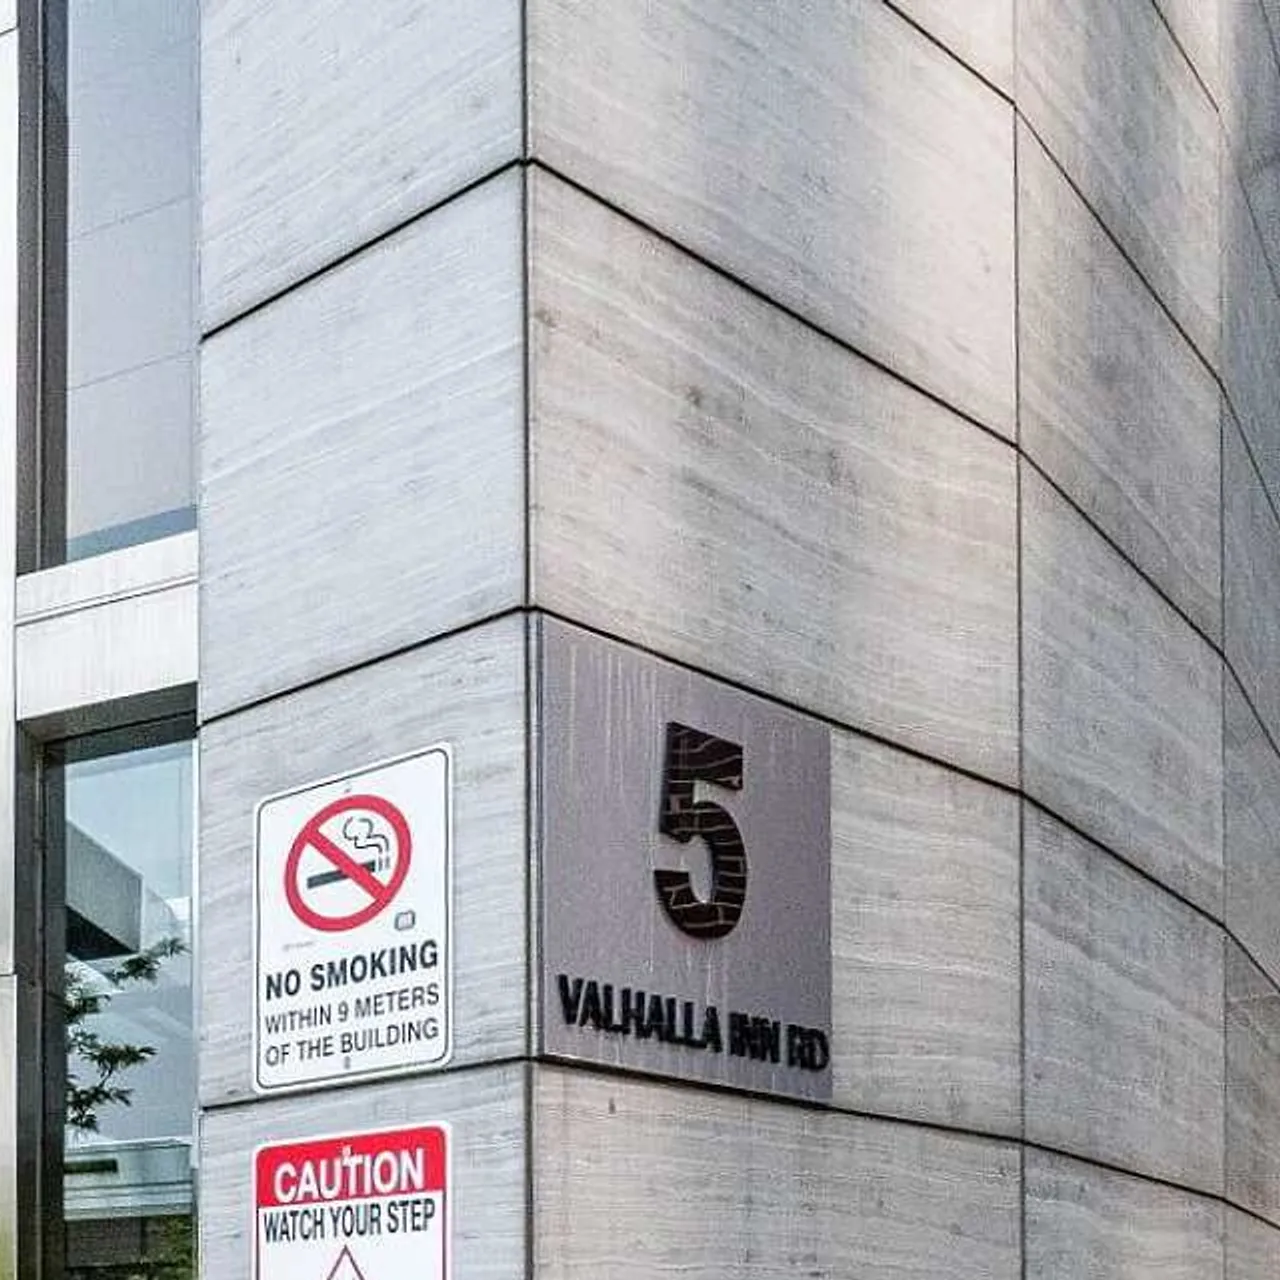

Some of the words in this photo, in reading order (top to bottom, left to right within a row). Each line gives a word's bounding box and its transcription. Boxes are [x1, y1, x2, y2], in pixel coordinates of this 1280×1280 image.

[654, 720, 748, 940] 5
[265, 969, 301, 1001] NO
[310, 939, 438, 992] SMOKING
[265, 1003, 332, 1035] WITHIN
[339, 1001, 350, 1022] 9
[355, 982, 440, 1019] METERS
[558, 974, 723, 1054] VALHALLA
[728, 1011, 781, 1065] INN
[786, 1023, 831, 1072] RD
[265, 1043, 290, 1067] OF
[297, 1035, 334, 1061] THE
[341, 1017, 439, 1054] BUILDING
[273, 1146, 425, 1204] CAUTION
[263, 1208, 325, 1244] WATCH
[331, 1203, 383, 1239] YOUR
[387, 1197, 436, 1235] STEP
